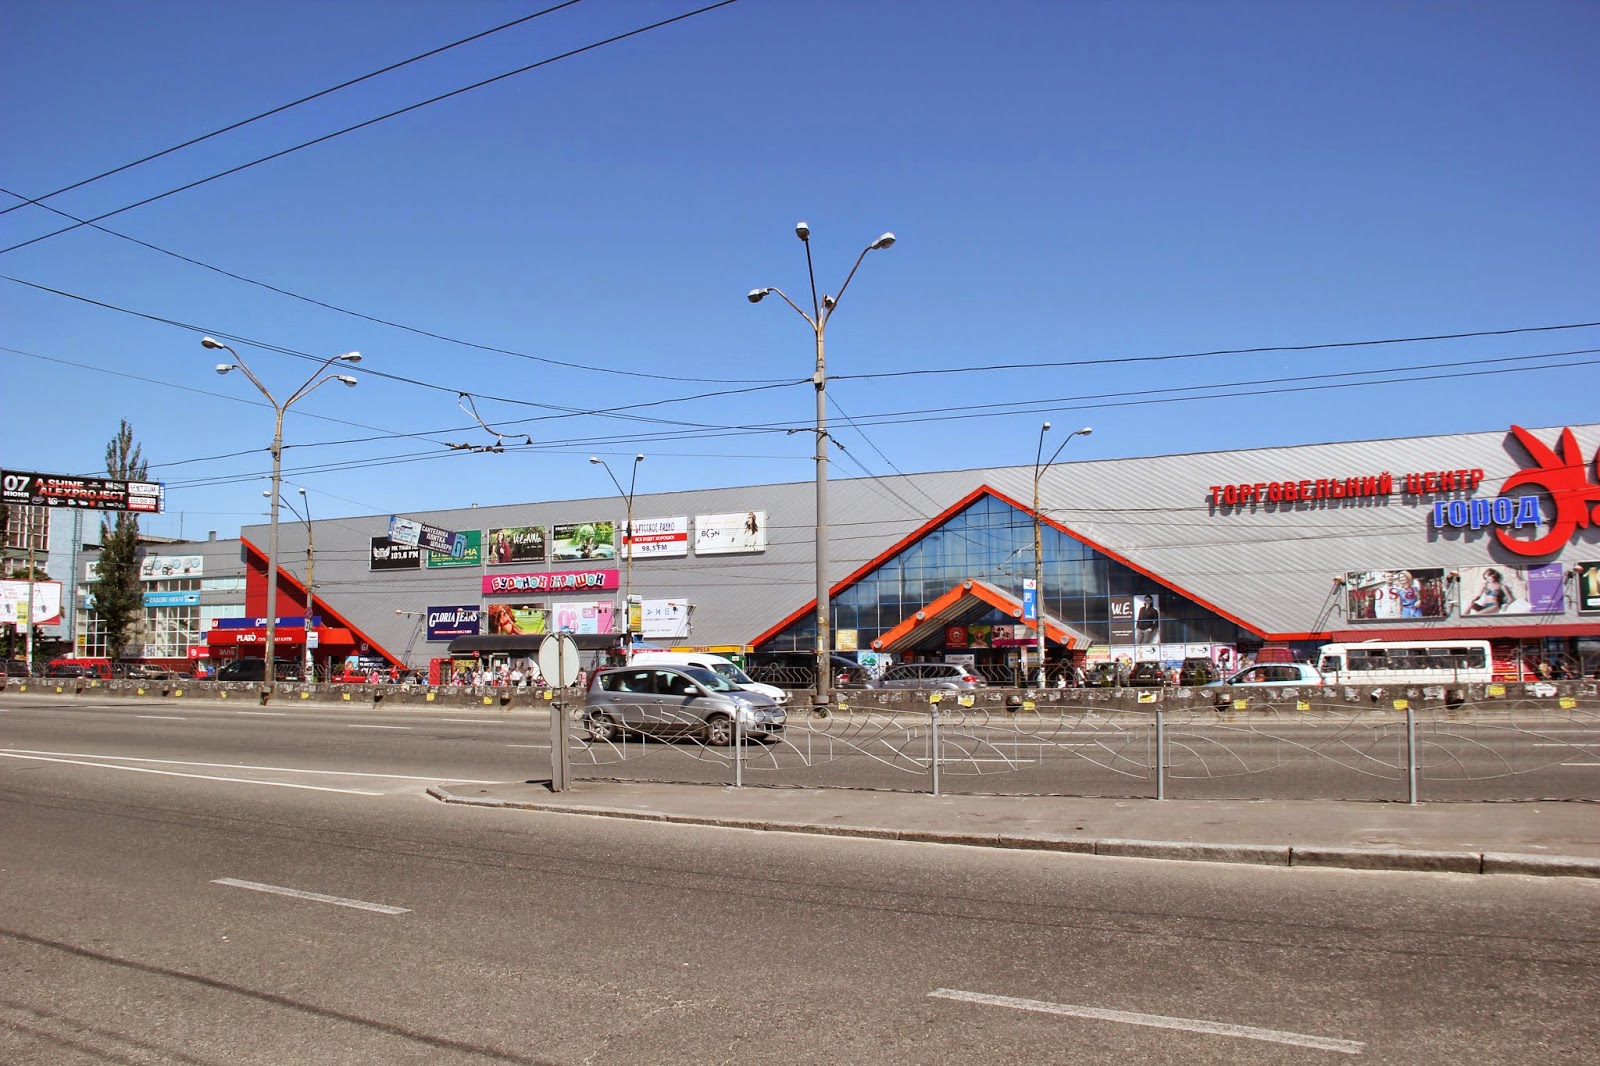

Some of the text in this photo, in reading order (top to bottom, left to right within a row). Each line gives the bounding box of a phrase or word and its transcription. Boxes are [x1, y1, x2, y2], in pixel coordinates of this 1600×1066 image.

[4, 474, 30, 492] 07
[1209, 468, 1484, 506] ТОРГОВЕЛЬНИЙ ЦЕНТР
[3, 490, 30, 498] ИЮНЯ
[408, 550, 419, 559] FM
[491, 575, 548, 591] БУДИНОК
[428, 611, 478, 628] GLORIA JEANS
